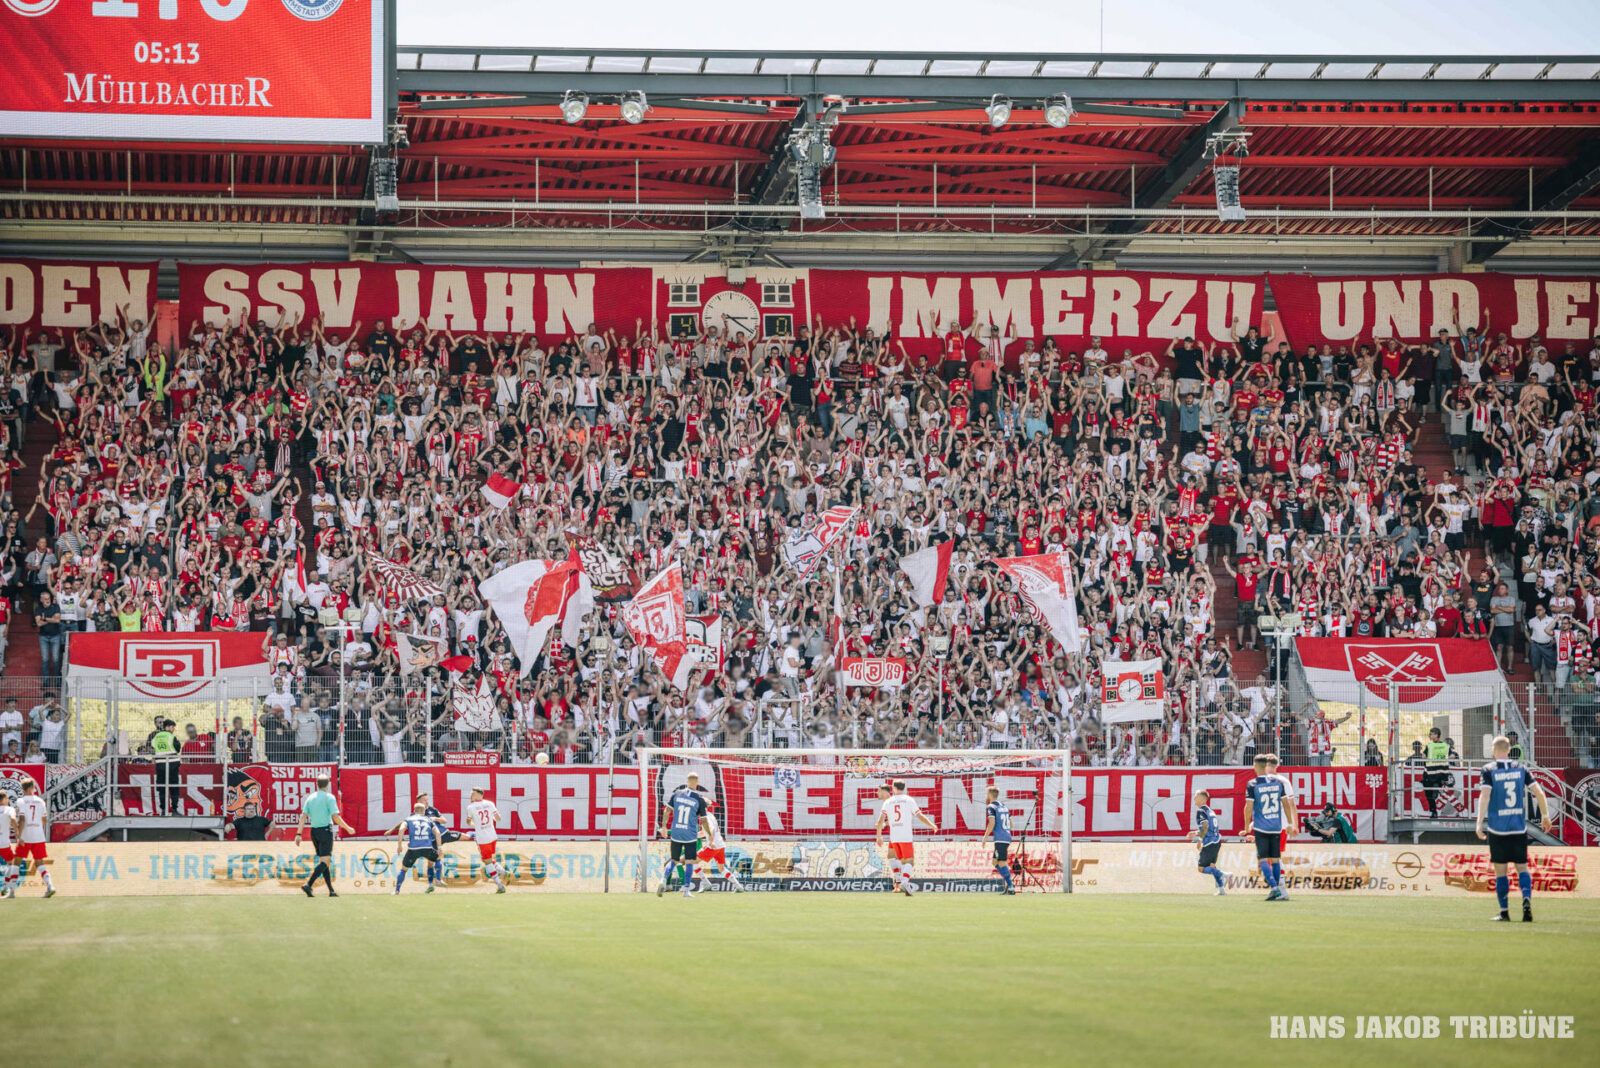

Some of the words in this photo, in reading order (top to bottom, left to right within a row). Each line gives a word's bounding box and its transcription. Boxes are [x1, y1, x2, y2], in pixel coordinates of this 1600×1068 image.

[134, 42, 200, 64] 05:13
[63, 73, 273, 107] MÜHLBACHER
[0, 263, 151, 328] DEN
[203, 268, 361, 331] SSV
[391, 269, 596, 335] JAHN
[867, 275, 1256, 342] IMMERZU
[1317, 278, 1480, 341] UND
[1511, 278, 1600, 340] JE
[271, 767, 295, 779] SSV
[299, 767, 332, 779] JAHN
[272, 781, 332, 811] 188
[1288, 772, 1357, 806] AHN
[1504, 781, 1517, 808] 3
[29, 804, 36, 821] 7
[367, 772, 639, 831] ULTRAS
[743, 773, 1235, 832] REGENSBURG
[1260, 793, 1279, 815] 23
[478, 809, 490, 825] 23
[677, 805, 691, 825] 11
[894, 804, 902, 822] 5
[412, 821, 430, 836] 32
[66, 855, 120, 880] TVA
[149, 854, 217, 880] IHRE
[1129, 850, 1167, 868] MIT
[922, 881, 999, 892] Dallmeier
[1387, 883, 1431, 891] OPEL
